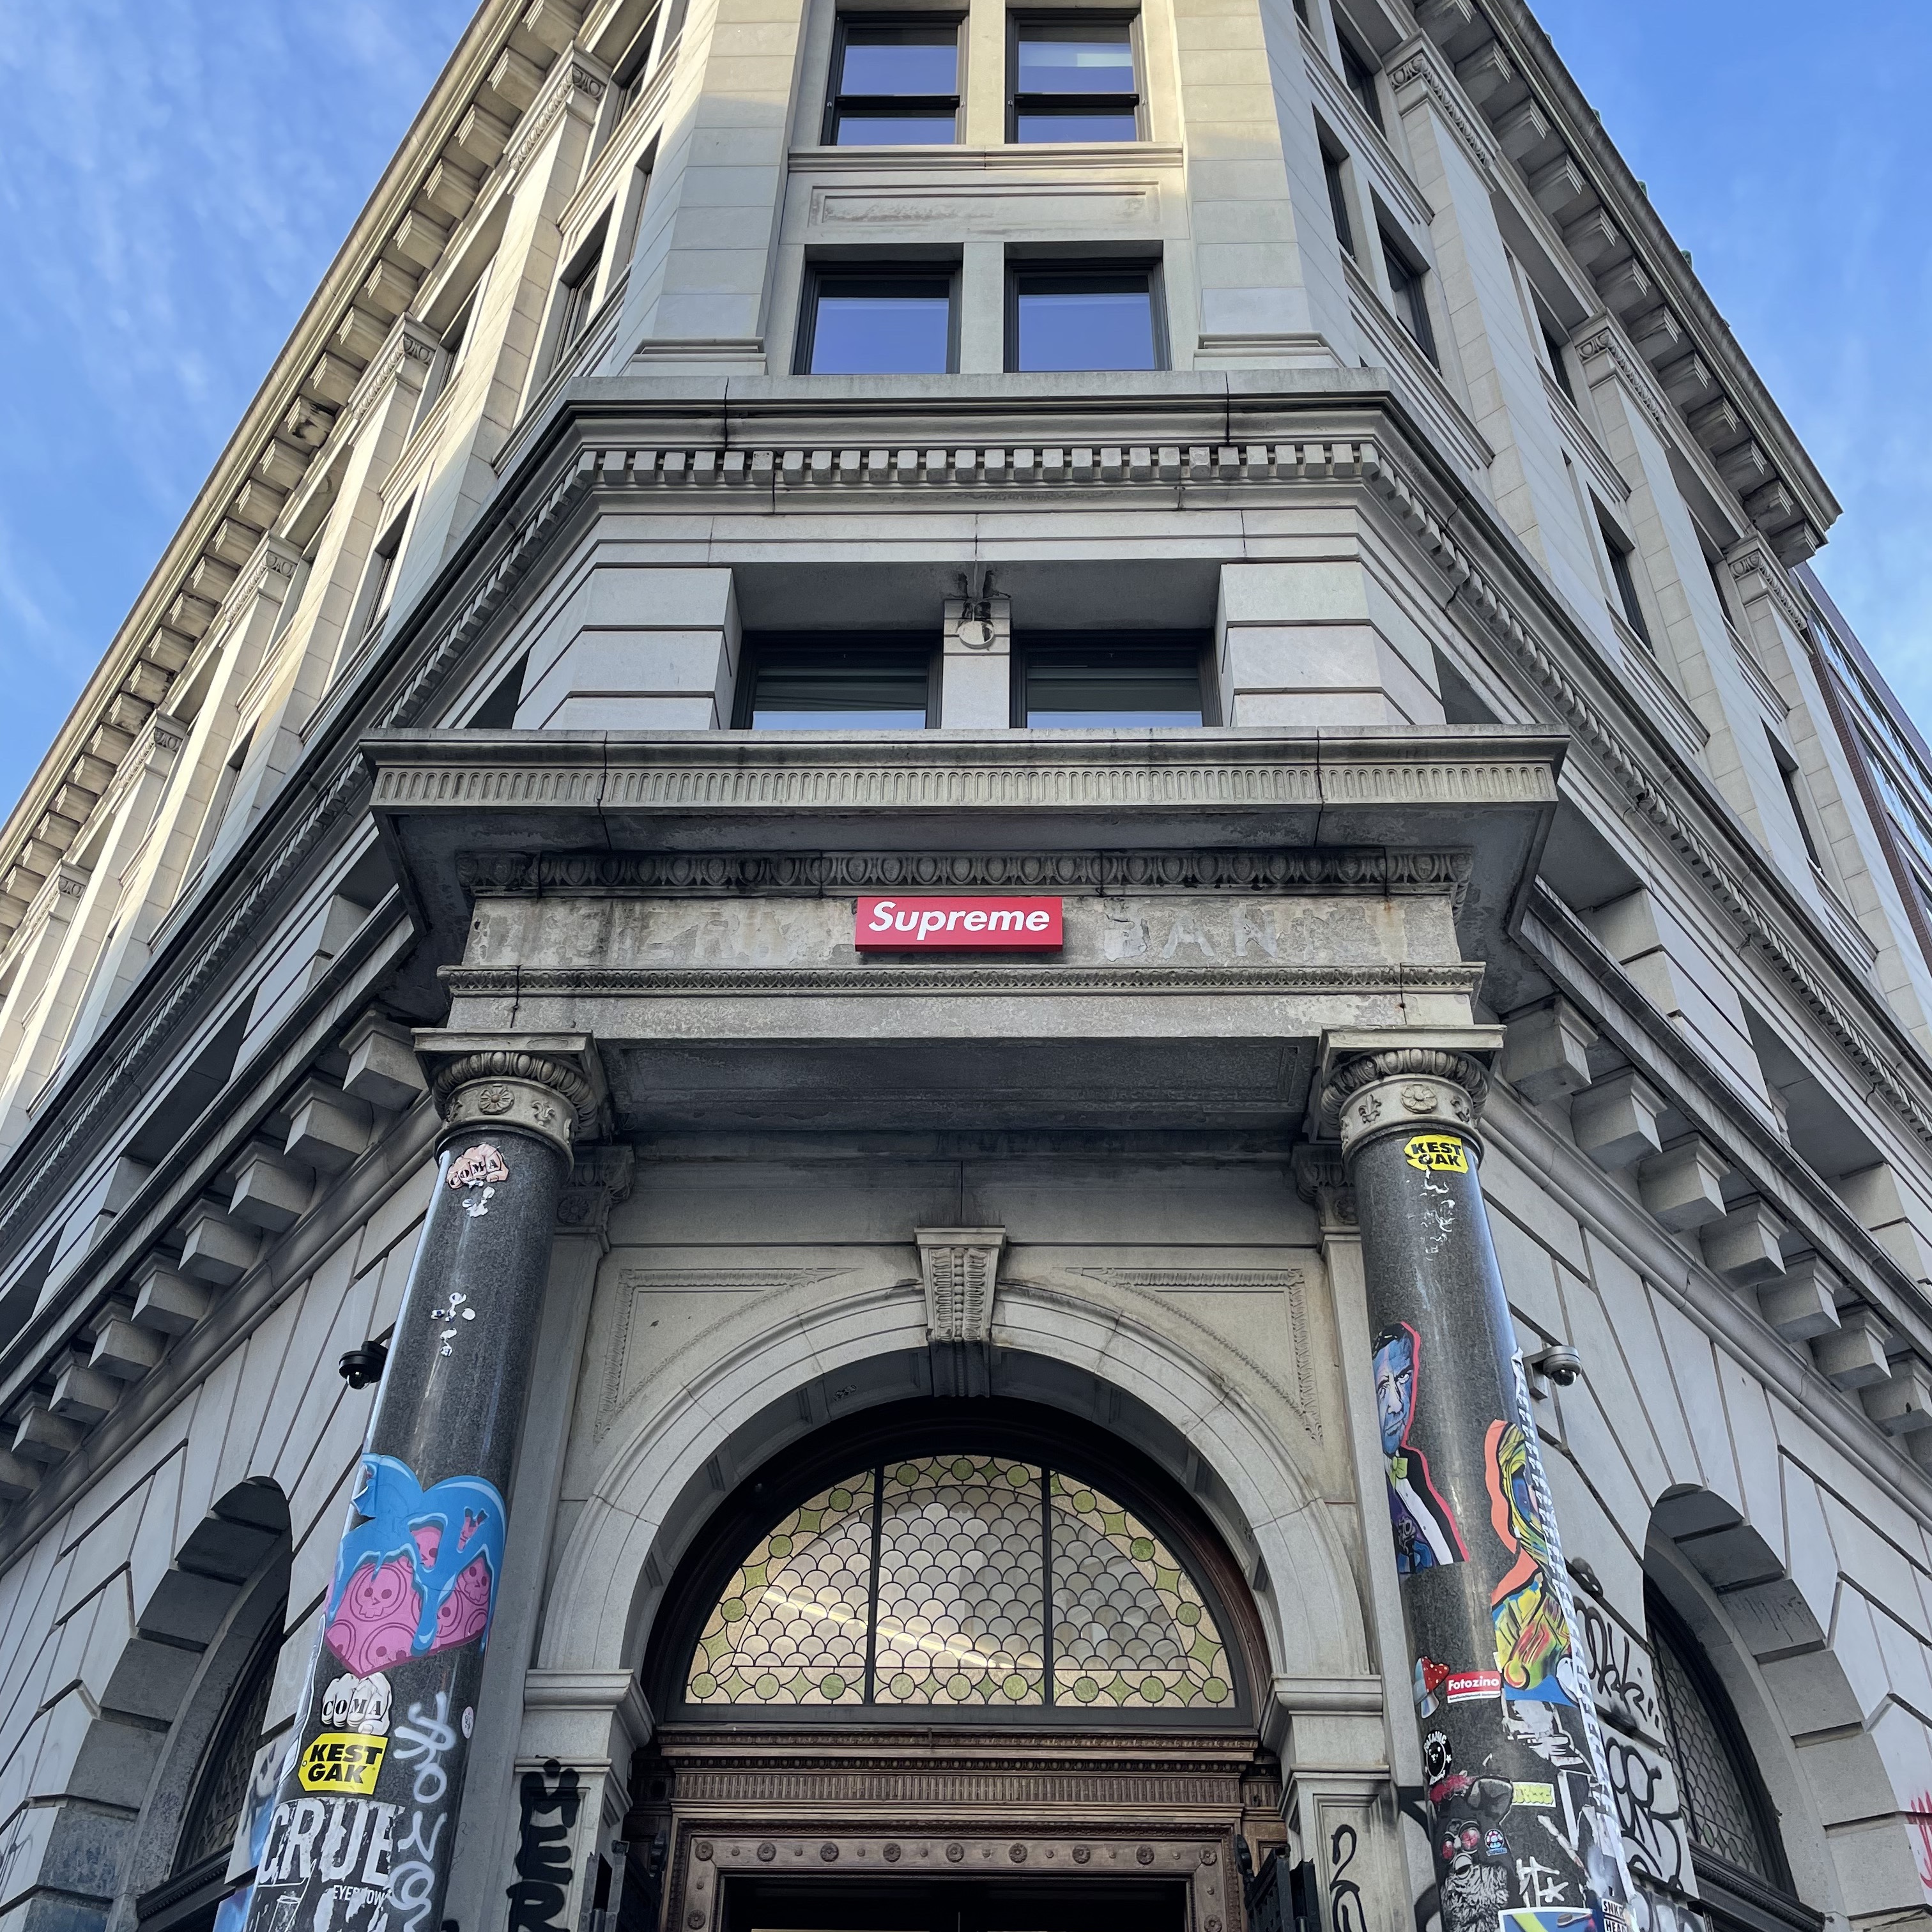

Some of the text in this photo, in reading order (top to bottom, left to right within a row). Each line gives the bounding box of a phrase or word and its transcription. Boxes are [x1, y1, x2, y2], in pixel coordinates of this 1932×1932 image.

[868, 901, 1050, 940] Supreme
[1411, 1142, 1461, 1156] KEST
[1448, 1675, 1499, 1692] Fotozino
[323, 1699, 381, 1716] COMA
[309, 1744, 383, 1765] KEST
[307, 1763, 367, 1784] GAK
